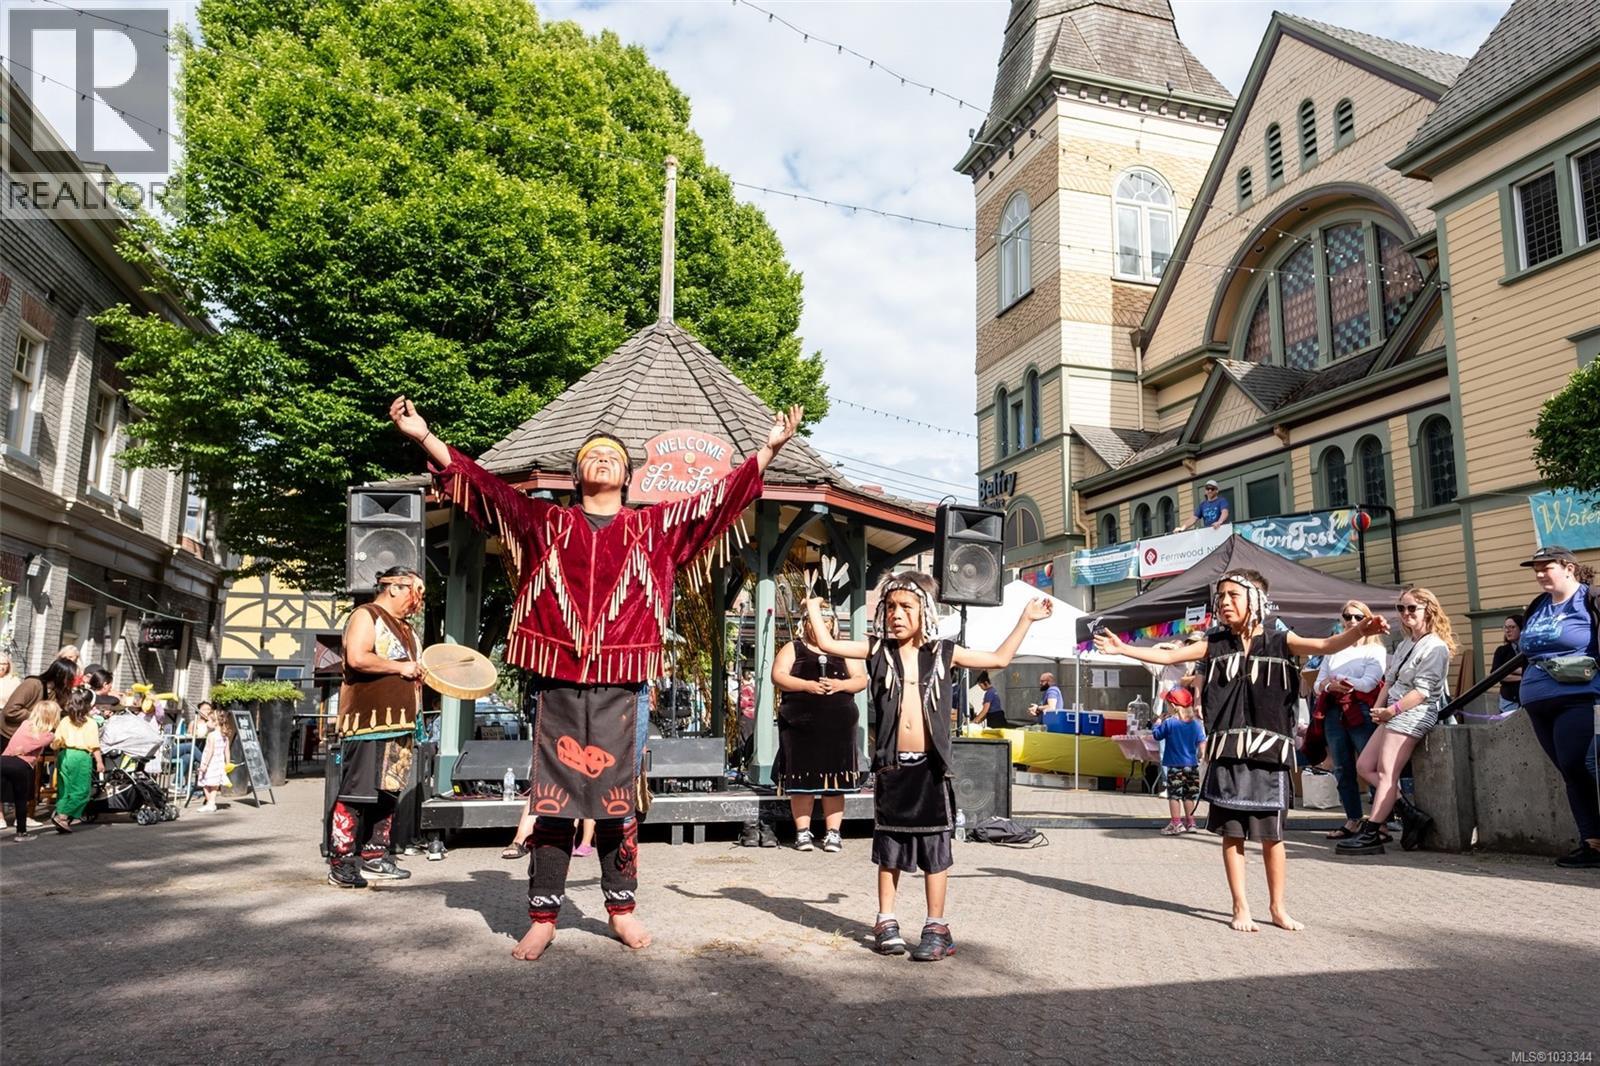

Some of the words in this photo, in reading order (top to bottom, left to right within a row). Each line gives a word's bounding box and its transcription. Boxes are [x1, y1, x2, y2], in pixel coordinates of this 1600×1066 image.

[655, 436, 726, 461] WELCOME
[640, 463, 718, 494] FernFe
[979, 470, 1017, 500] Belfry
[1251, 511, 1337, 551] FernFest
[1160, 548, 1204, 562] Fernwood
